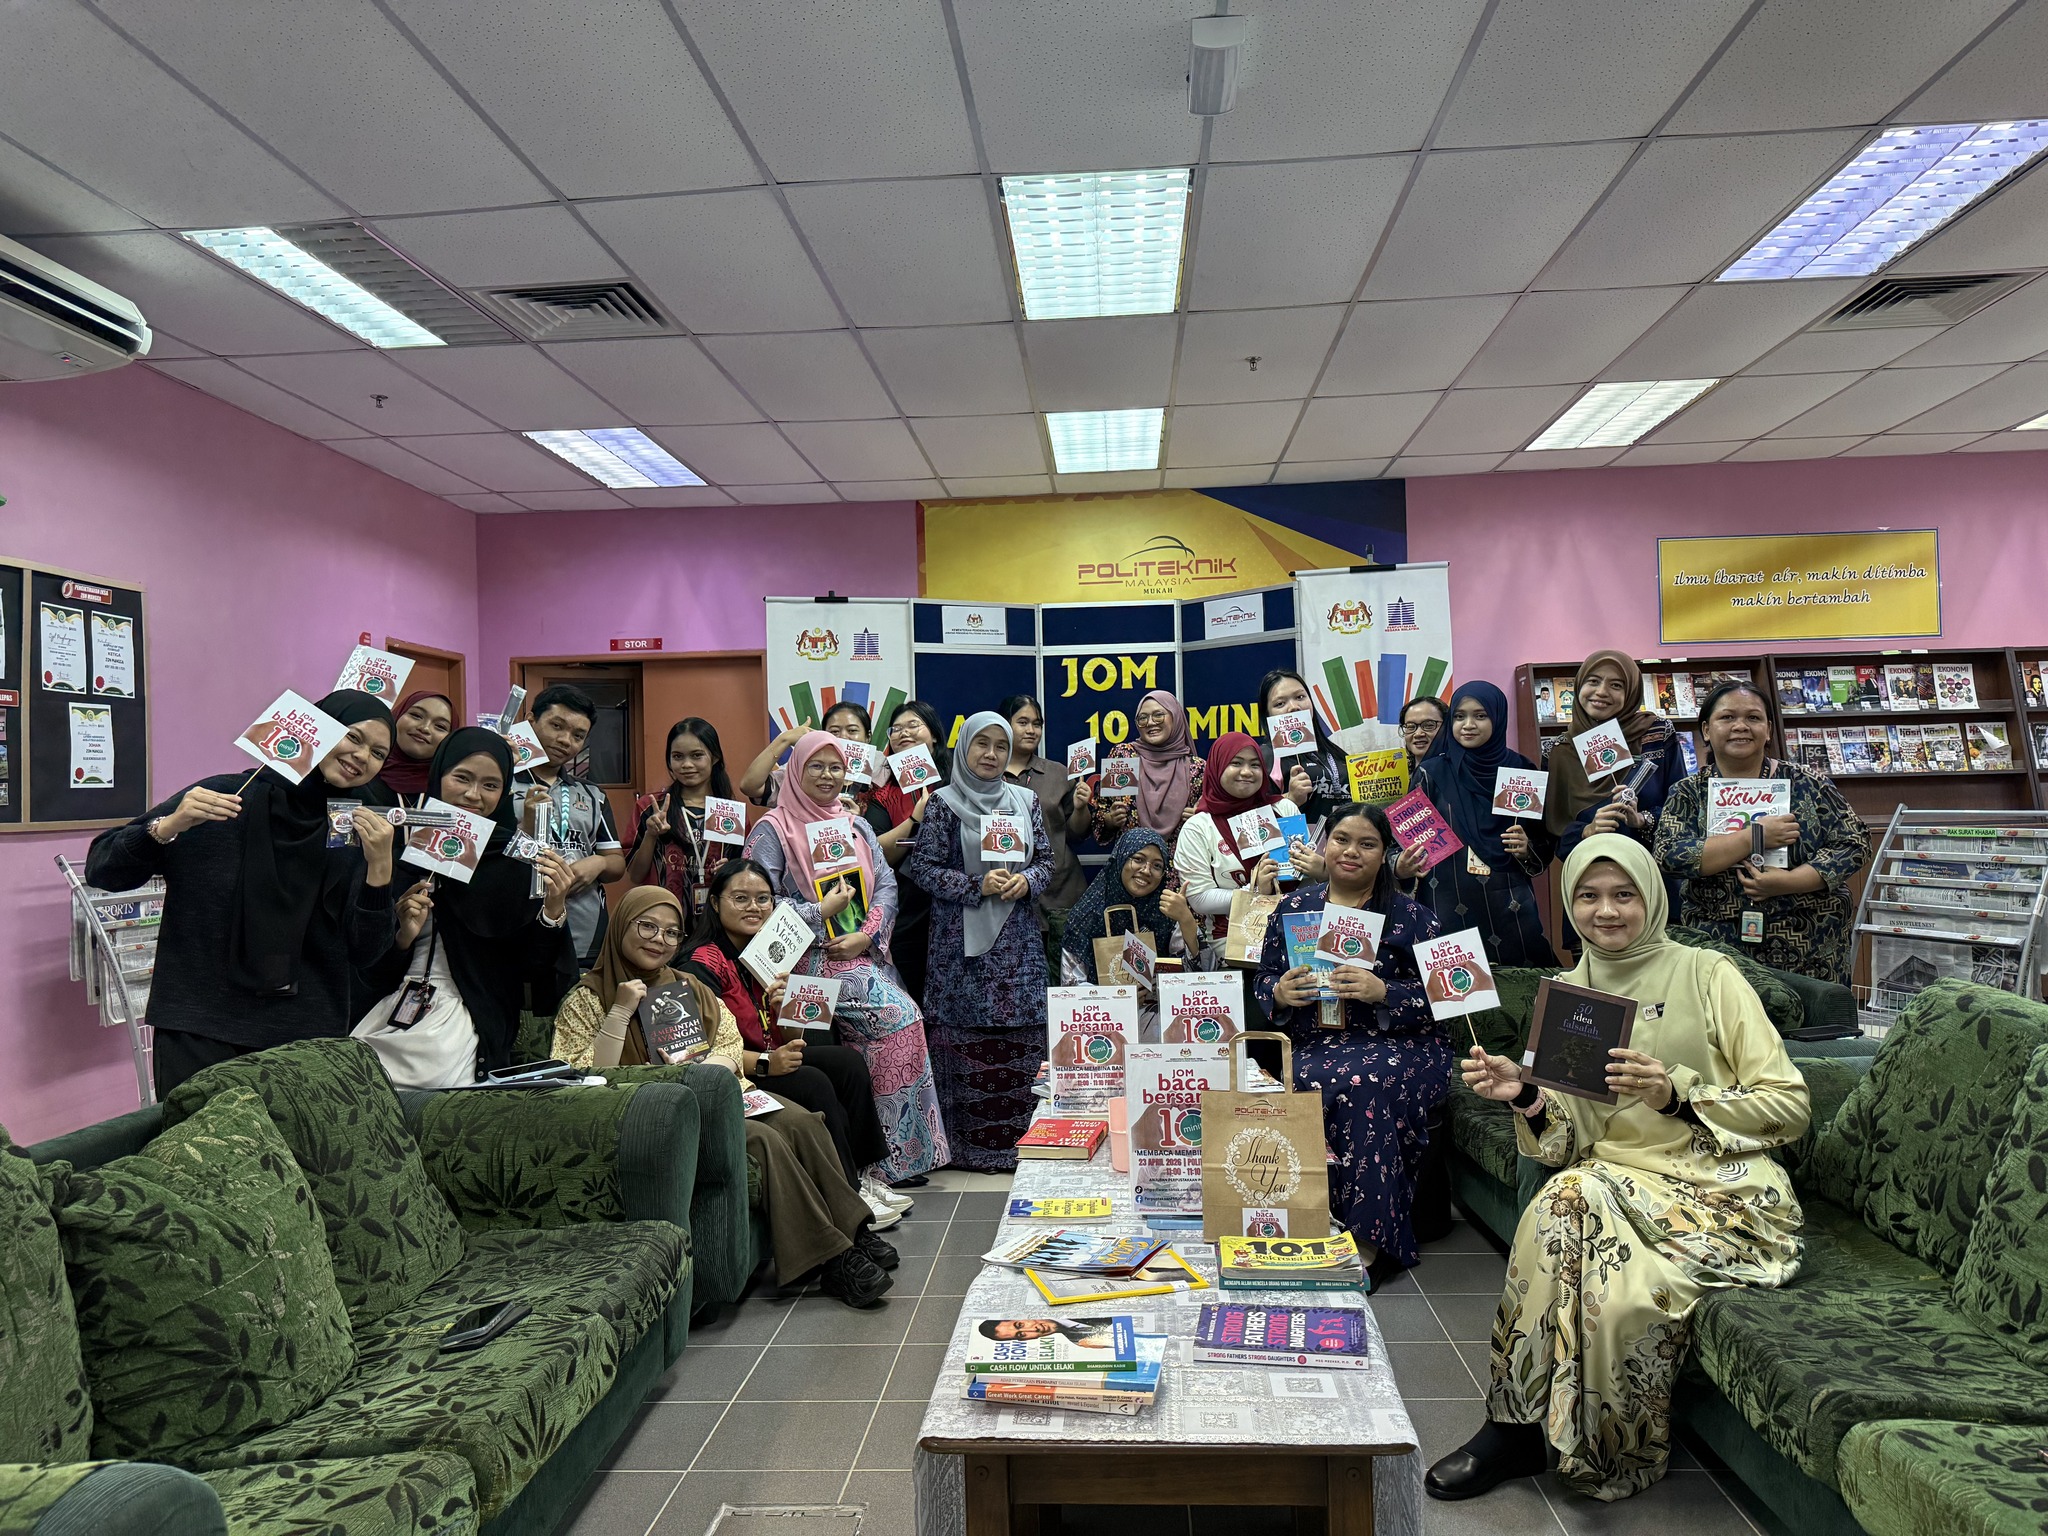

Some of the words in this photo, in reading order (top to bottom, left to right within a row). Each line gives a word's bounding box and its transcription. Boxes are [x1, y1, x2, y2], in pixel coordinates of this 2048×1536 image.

[1078, 557, 1237, 579] POLITEKNIK
[1674, 570, 1710, 586] Ilmu
[1714, 567, 1764, 585] ibarat
[1772, 567, 1803, 585] air,
[1806, 565, 1858, 582] makin
[1863, 562, 1927, 580] ditimba
[1125, 577, 1192, 587] MALAYSIA
[1143, 587, 1173, 595] MUKAH
[1731, 591, 1783, 608] makin
[1787, 589, 1871, 606] bertambah
[624, 640, 647, 648] STOR
[365, 657, 392, 672] baca
[1061, 655, 1158, 698] JOM
[287, 709, 318, 736] baca
[301, 712, 316, 723] JOM
[1085, 710, 1129, 744] 10
[1188, 702, 1266, 740] MIN
[1278, 716, 1299, 726] baca
[271, 711, 321, 748] bersama
[1274, 720, 1306, 732] bersama
[260, 727, 300, 758] 10
[1281, 729, 1303, 746] 10
[1586, 734, 1609, 748] baca
[278, 743, 294, 752] minit
[846, 744, 865, 752] baca
[1582, 737, 1618, 756] bersama
[897, 757, 927, 772] bersama
[900, 755, 920, 765] baca
[1592, 748, 1616, 771] 10
[905, 767, 927, 784] 10
[1354, 759, 1398, 778] Siswa
[1110, 773, 1129, 787] 10
[1358, 782, 1402, 794] IDENTITI
[1501, 782, 1538, 793] bersama
[1509, 777, 1532, 787] baca
[1359, 790, 1403, 801] NASIONAL
[1505, 791, 1531, 810] 10
[1715, 786, 1775, 807] Siswa
[716, 802, 734, 812] baca
[1392, 800, 1424, 825] STRONG
[715, 816, 735, 832] 10
[992, 819, 1012, 828] baca
[1396, 806, 1433, 835] MOTHERS
[1404, 816, 1436, 841] STRONG
[818, 827, 839, 838] baca
[985, 826, 1019, 834] bersama
[1414, 827, 1436, 846] SONS
[426, 830, 465, 858] 10
[813, 833, 847, 845] bersama
[992, 834, 1014, 850] 10
[821, 842, 845, 860] 10
[99, 902, 134, 918] SPORTS
[779, 916, 804, 944] Psychology
[1327, 921, 1372, 938] bersama
[1337, 916, 1365, 930] baca
[772, 924, 798, 954] Money
[1331, 934, 1361, 956] 10
[1437, 940, 1451, 949] JOM
[1430, 944, 1462, 961] baca
[1424, 951, 1475, 972] bersama
[1437, 967, 1472, 998] 10
[1453, 975, 1467, 985] minit
[790, 991, 829, 1002] bersama
[800, 985, 823, 996] baca
[1182, 994, 1219, 1006] baca
[794, 1002, 819, 1020] 10
[1072, 1009, 1111, 1022] baca
[1083, 1005, 1100, 1013] JOM
[1171, 1005, 1230, 1016] bersama
[1576, 1003, 1593, 1015] 50
[1060, 1021, 1124, 1032] bersama
[1572, 1012, 1593, 1025] idea
[1183, 1018, 1221, 1043] 10
[1200, 1028, 1214, 1036] minit
[1562, 1019, 1599, 1036] falsafah
[670, 1037, 703, 1049] BROTHER
[1072, 1036, 1113, 1064] 10
[1172, 1069, 1194, 1078] JOM
[1158, 1073, 1210, 1091] baca
[1159, 1109, 1201, 1147] 10
[1183, 1123, 1202, 1133] mini
[1232, 1133, 1280, 1167] Thank
[1251, 1164, 1287, 1201] You
[1256, 1223, 1275, 1237] 10
[1246, 1241, 1326, 1257] 101
[1222, 1311, 1245, 1343] STRONG
[1244, 1311, 1267, 1346] FATHERS
[1267, 1314, 1289, 1345] STRONG
[1289, 1313, 1306, 1348] DAUGHTERS
[993, 1342, 1011, 1361] CASH
[1011, 1339, 1028, 1361] FLOW
[1039, 1336, 1055, 1360] LELAKI
[1009, 1363, 1028, 1371] FLOW
[1267, 1355, 1296, 1363] DAUGHTERS
[988, 1391, 1003, 1399] Great
